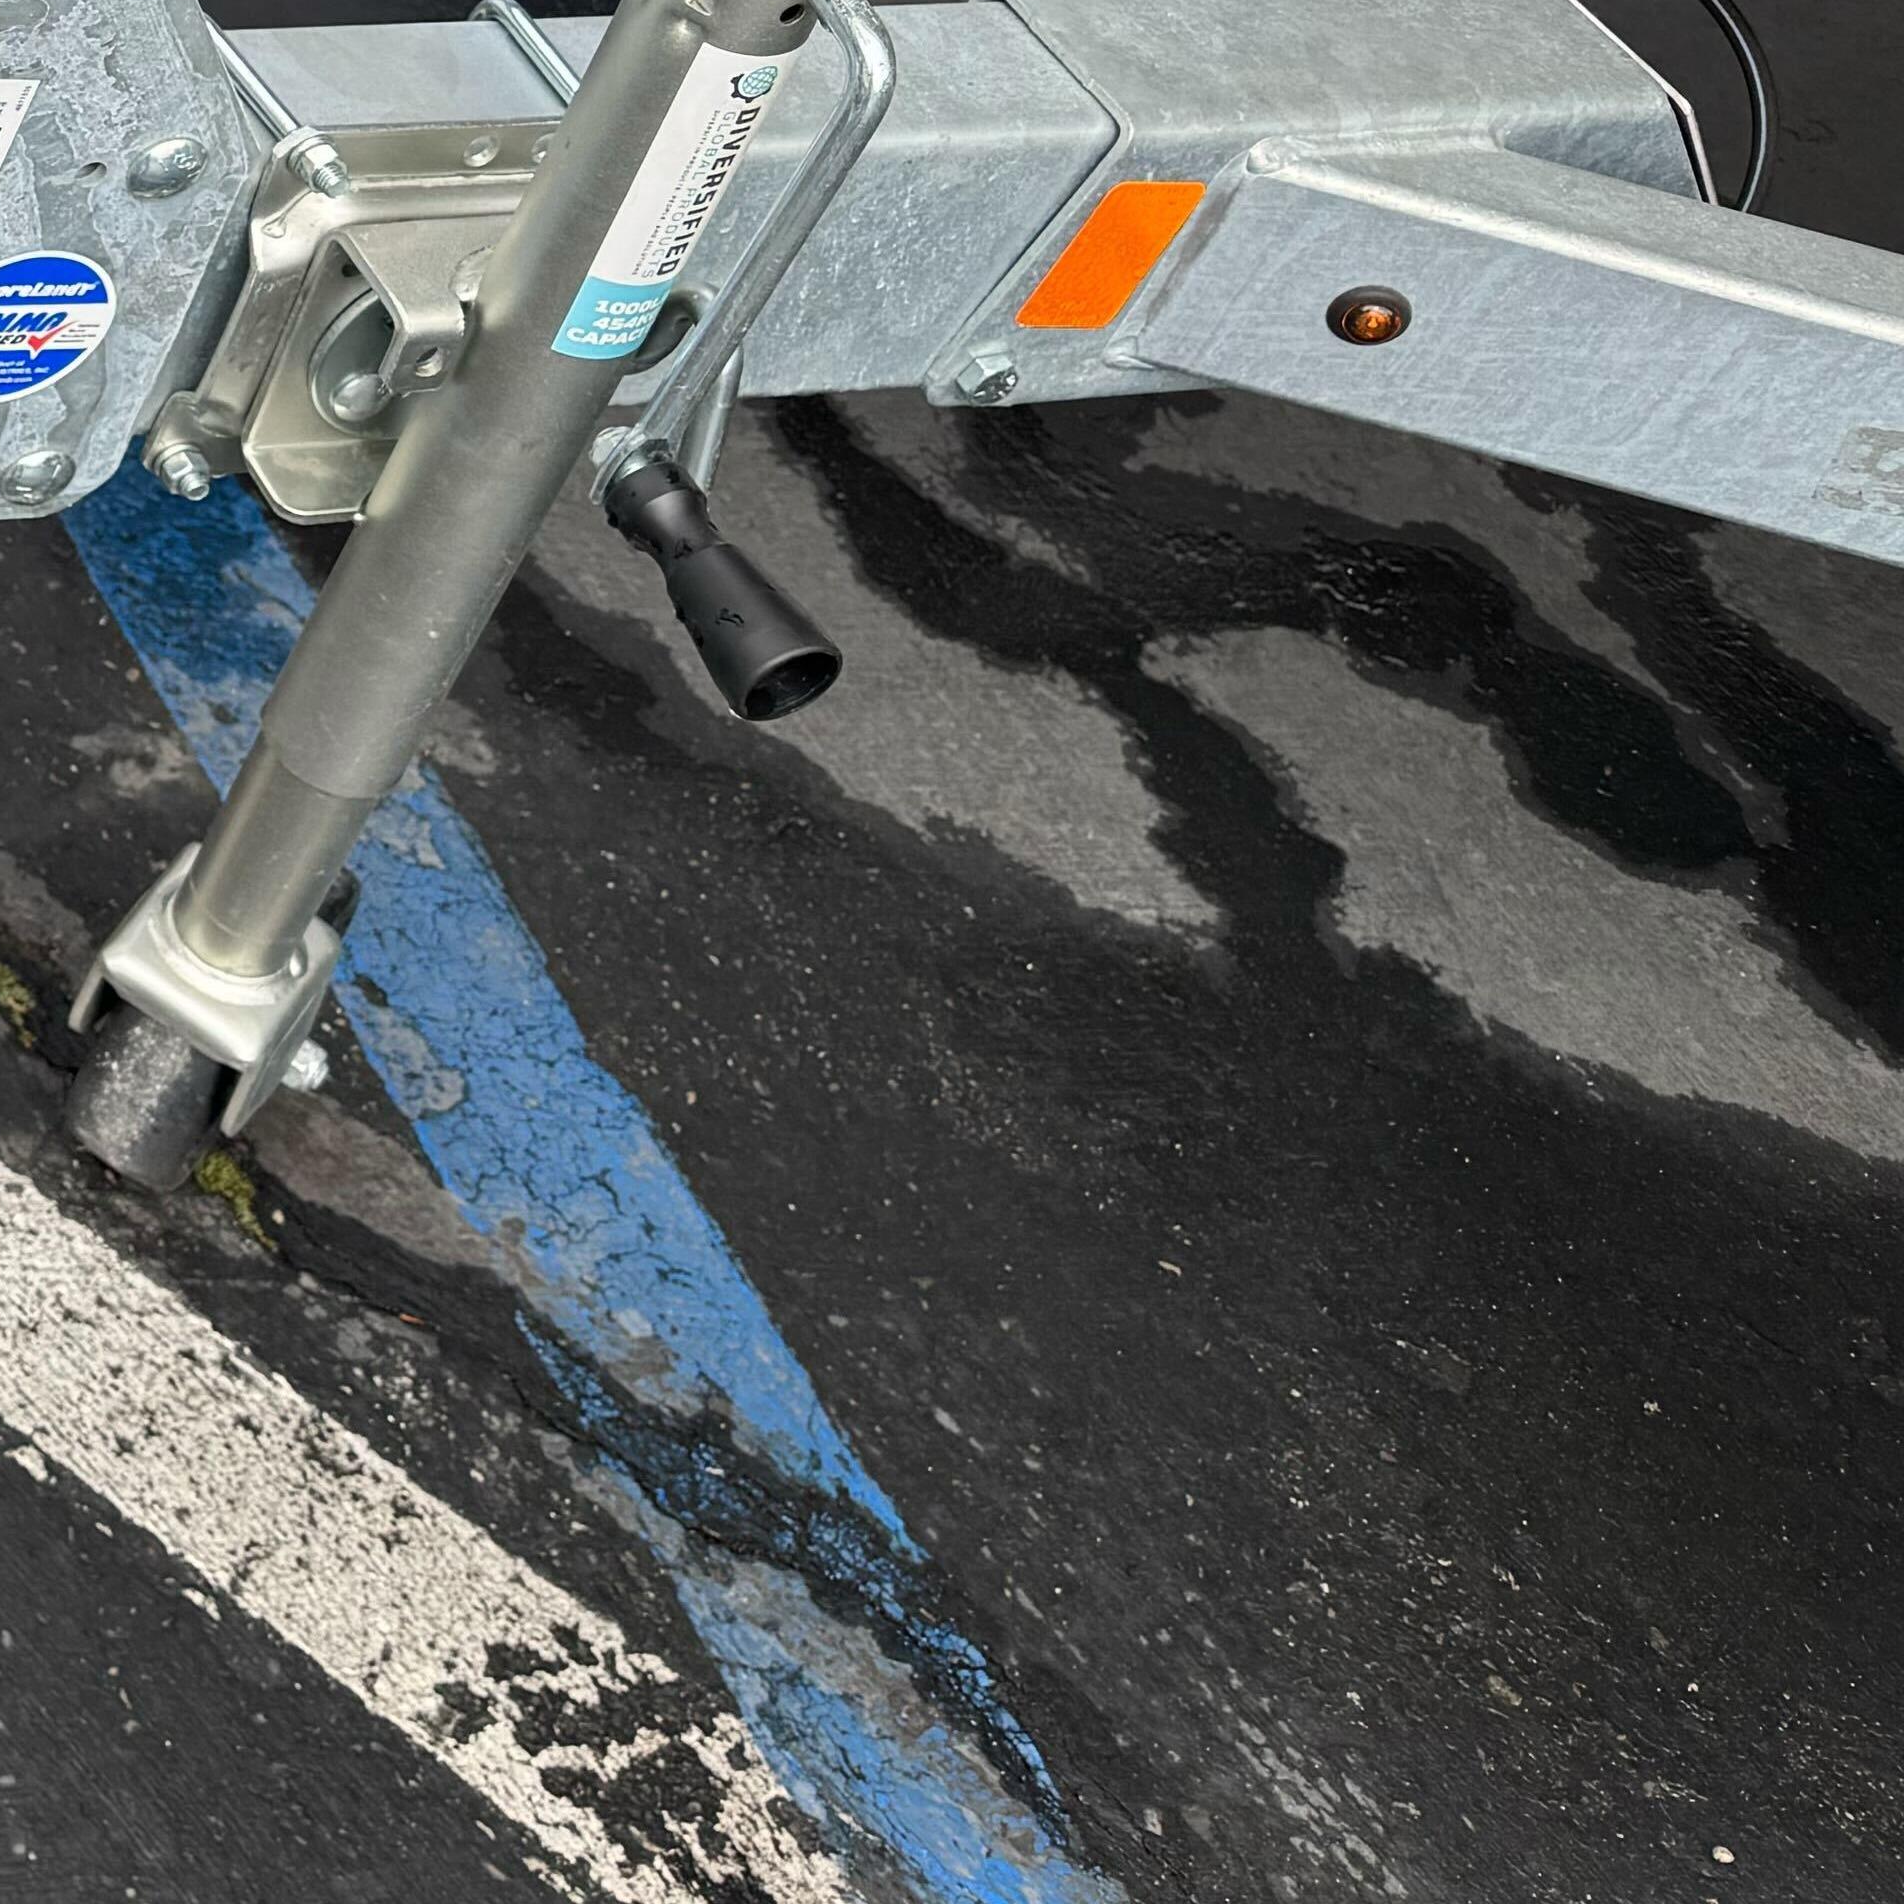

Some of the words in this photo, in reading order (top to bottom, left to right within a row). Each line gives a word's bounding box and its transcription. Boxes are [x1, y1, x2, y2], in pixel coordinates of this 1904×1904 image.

[692, 111, 736, 180] GLOBAL
[656, 106, 761, 277] DIVERSIFIED
[643, 187, 696, 279] PRODUCTS
[595, 297, 660, 315] 1000L
